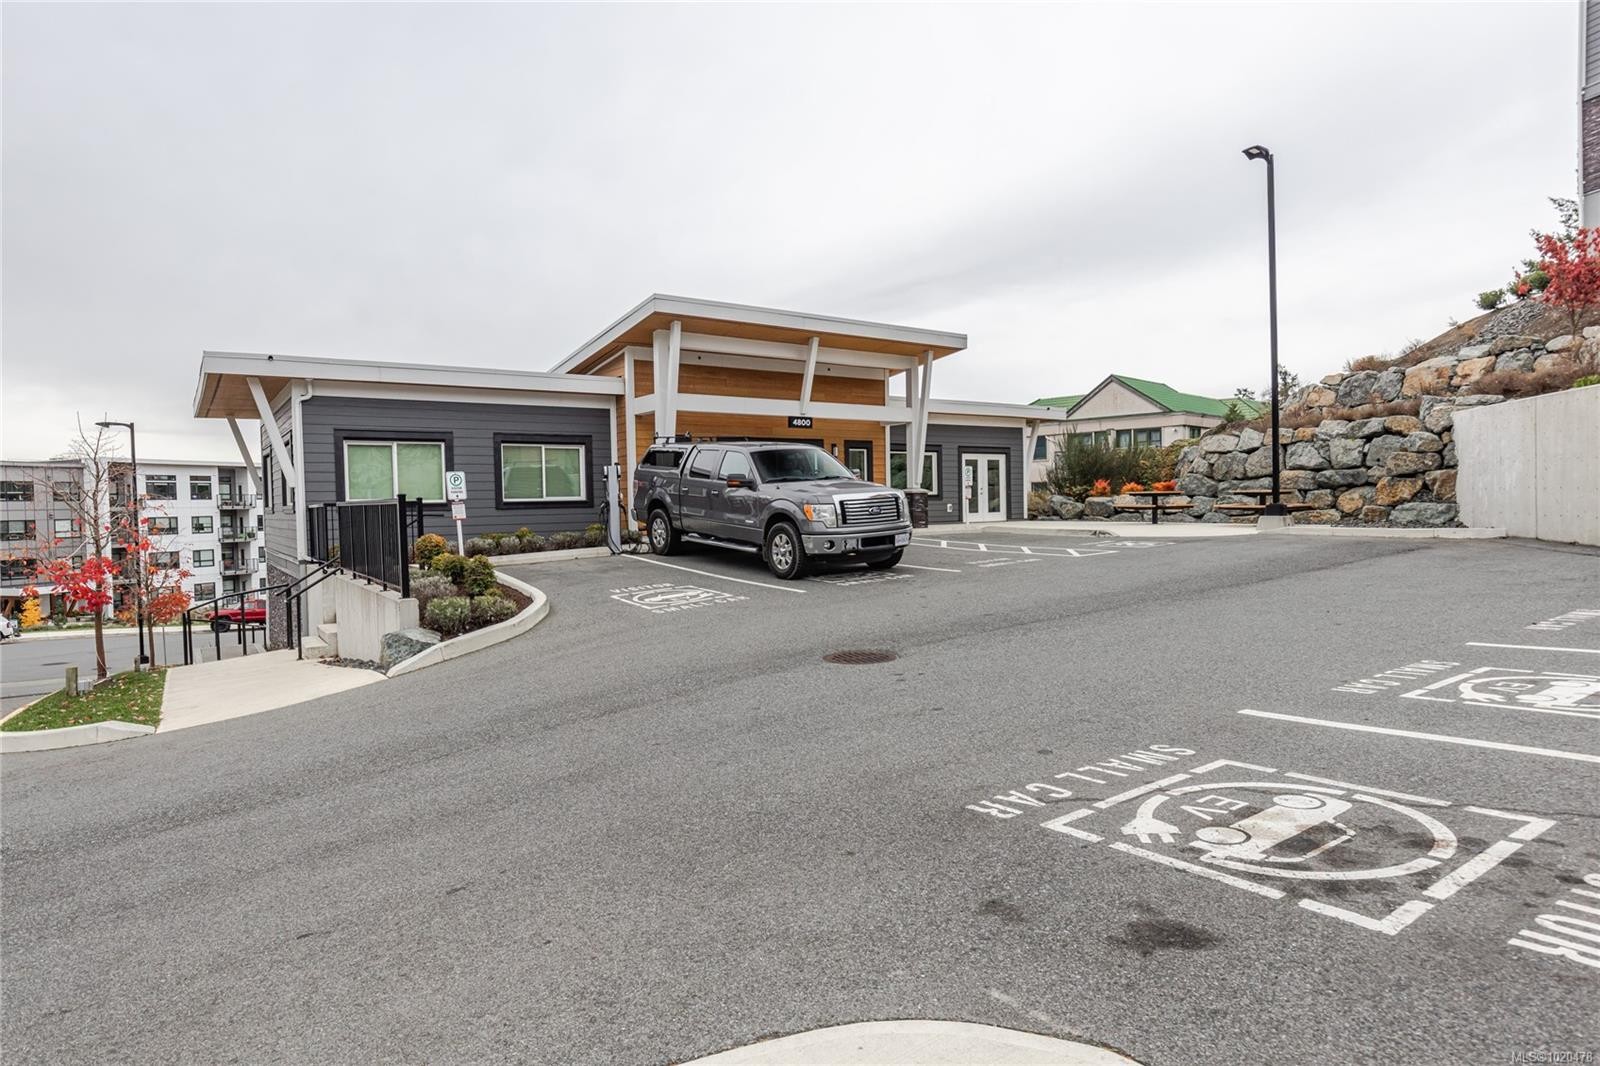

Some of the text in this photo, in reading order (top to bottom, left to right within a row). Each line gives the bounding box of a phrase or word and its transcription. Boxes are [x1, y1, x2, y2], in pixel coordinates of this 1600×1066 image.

[792, 418, 811, 427] 4800
[651, 602, 712, 613] SMALL
[1331, 659, 1460, 695] SMALL CAR
[1488, 681, 1536, 694] EV
[966, 743, 1196, 819] SMALL CAR
[1180, 793, 1250, 822] EV
